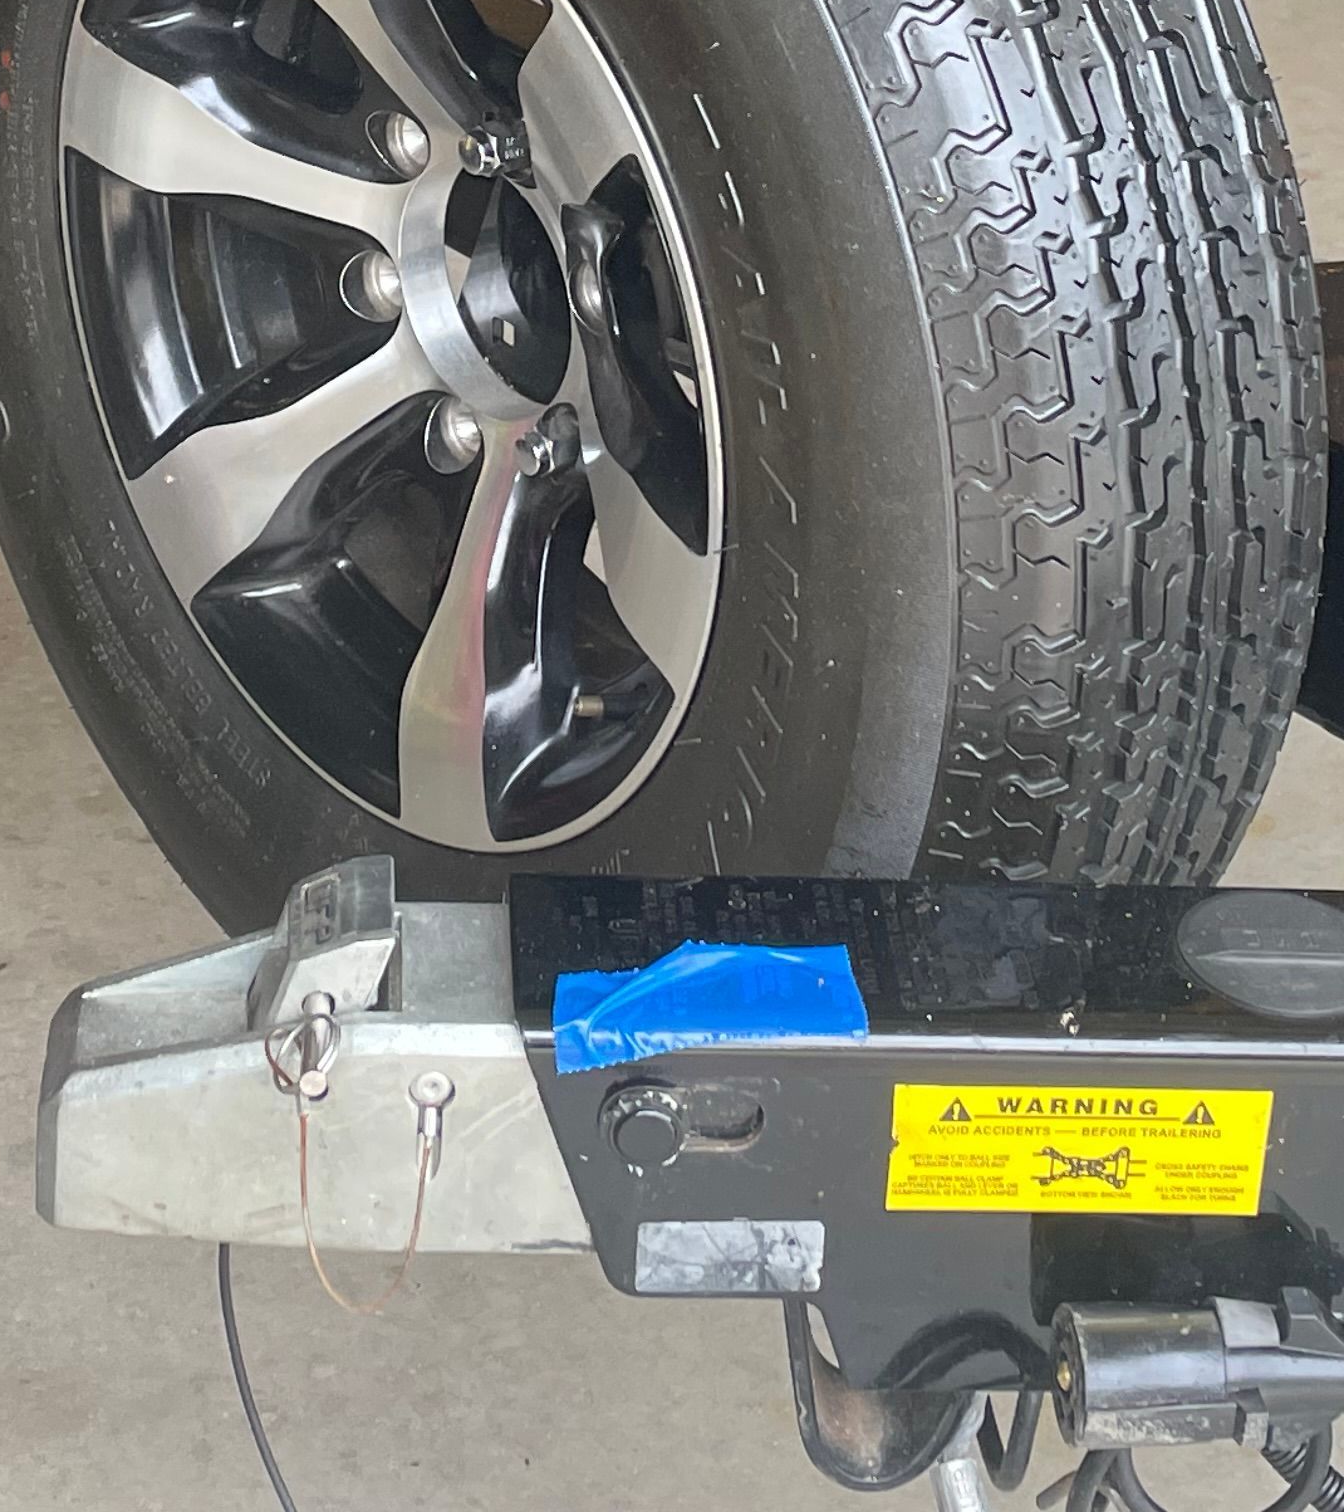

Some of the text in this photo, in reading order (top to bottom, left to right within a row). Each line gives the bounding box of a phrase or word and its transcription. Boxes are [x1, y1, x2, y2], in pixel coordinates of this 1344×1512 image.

[997, 1096, 1159, 1116] WARNING
[928, 1124, 1222, 1139] AVOID ACCIDENTS BEFORE TRAILERING
